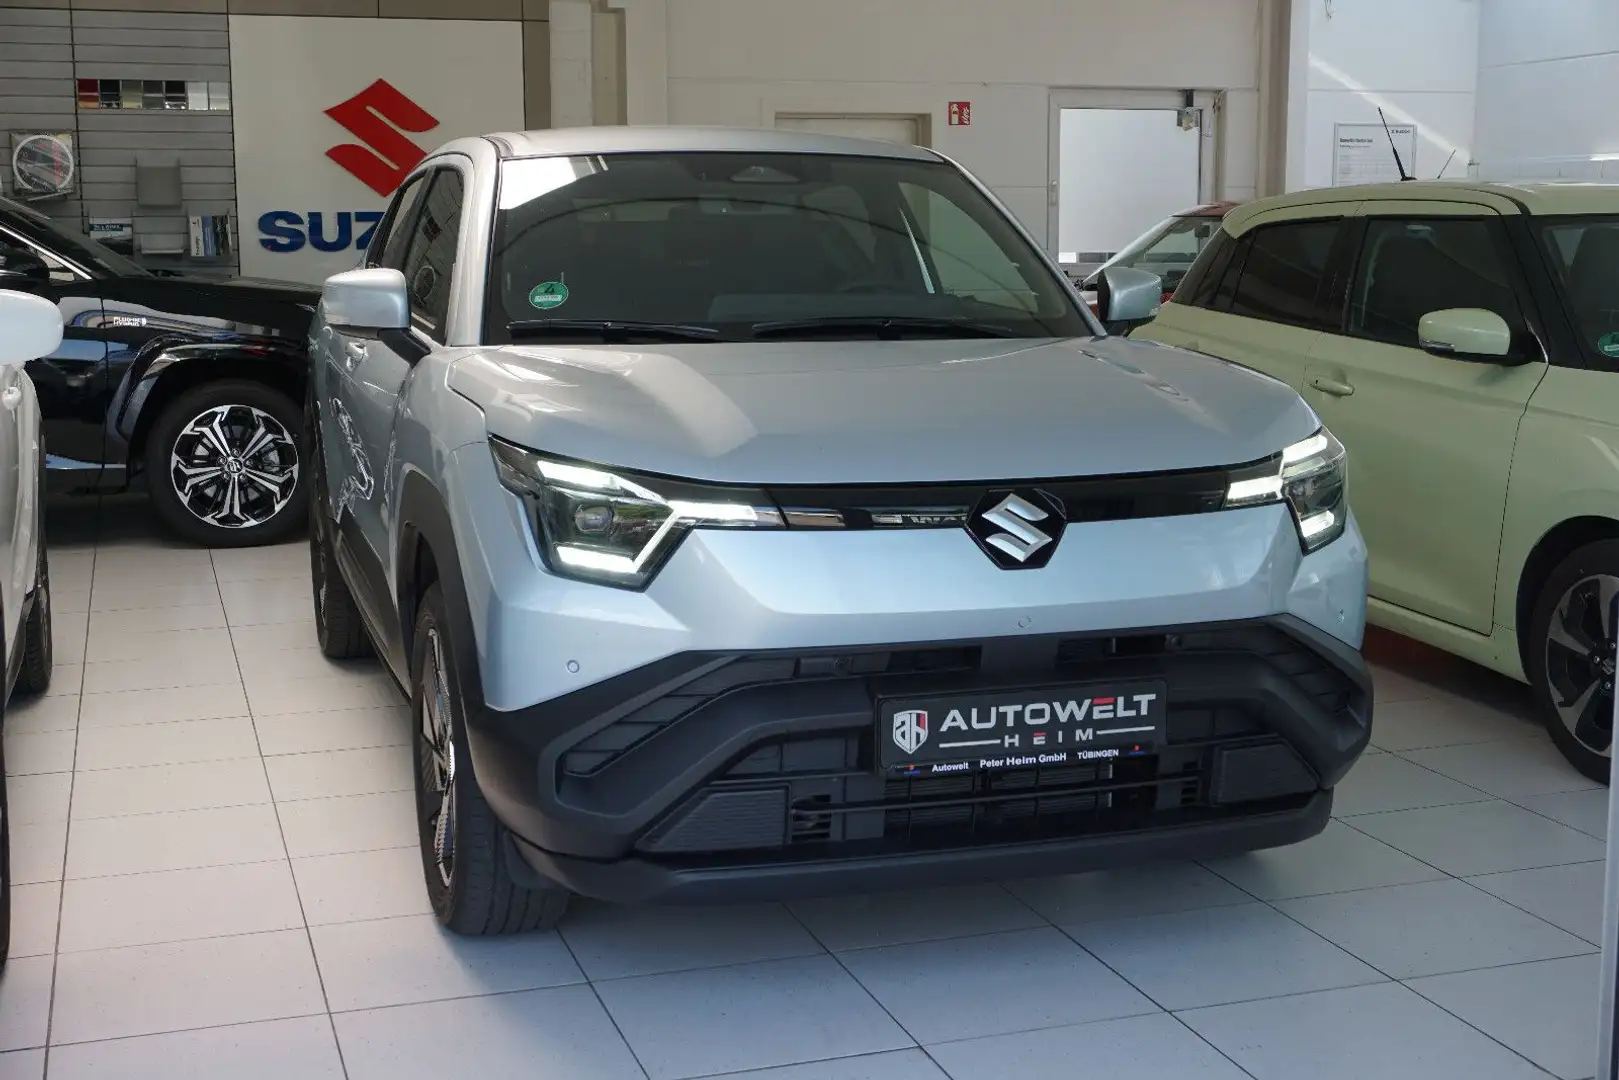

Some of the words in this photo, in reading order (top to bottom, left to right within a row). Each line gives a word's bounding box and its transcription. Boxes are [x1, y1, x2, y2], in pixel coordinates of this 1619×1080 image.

[939, 694, 1156, 732] AUTOWELT
[1004, 728, 1093, 748] HEIM
[931, 762, 969, 772] Autowelt
[979, 759, 1004, 768] Peter
[1006, 756, 1036, 766] Heim
[1038, 752, 1066, 763] GmbH
[1077, 749, 1119, 760] TÜBINGEN
